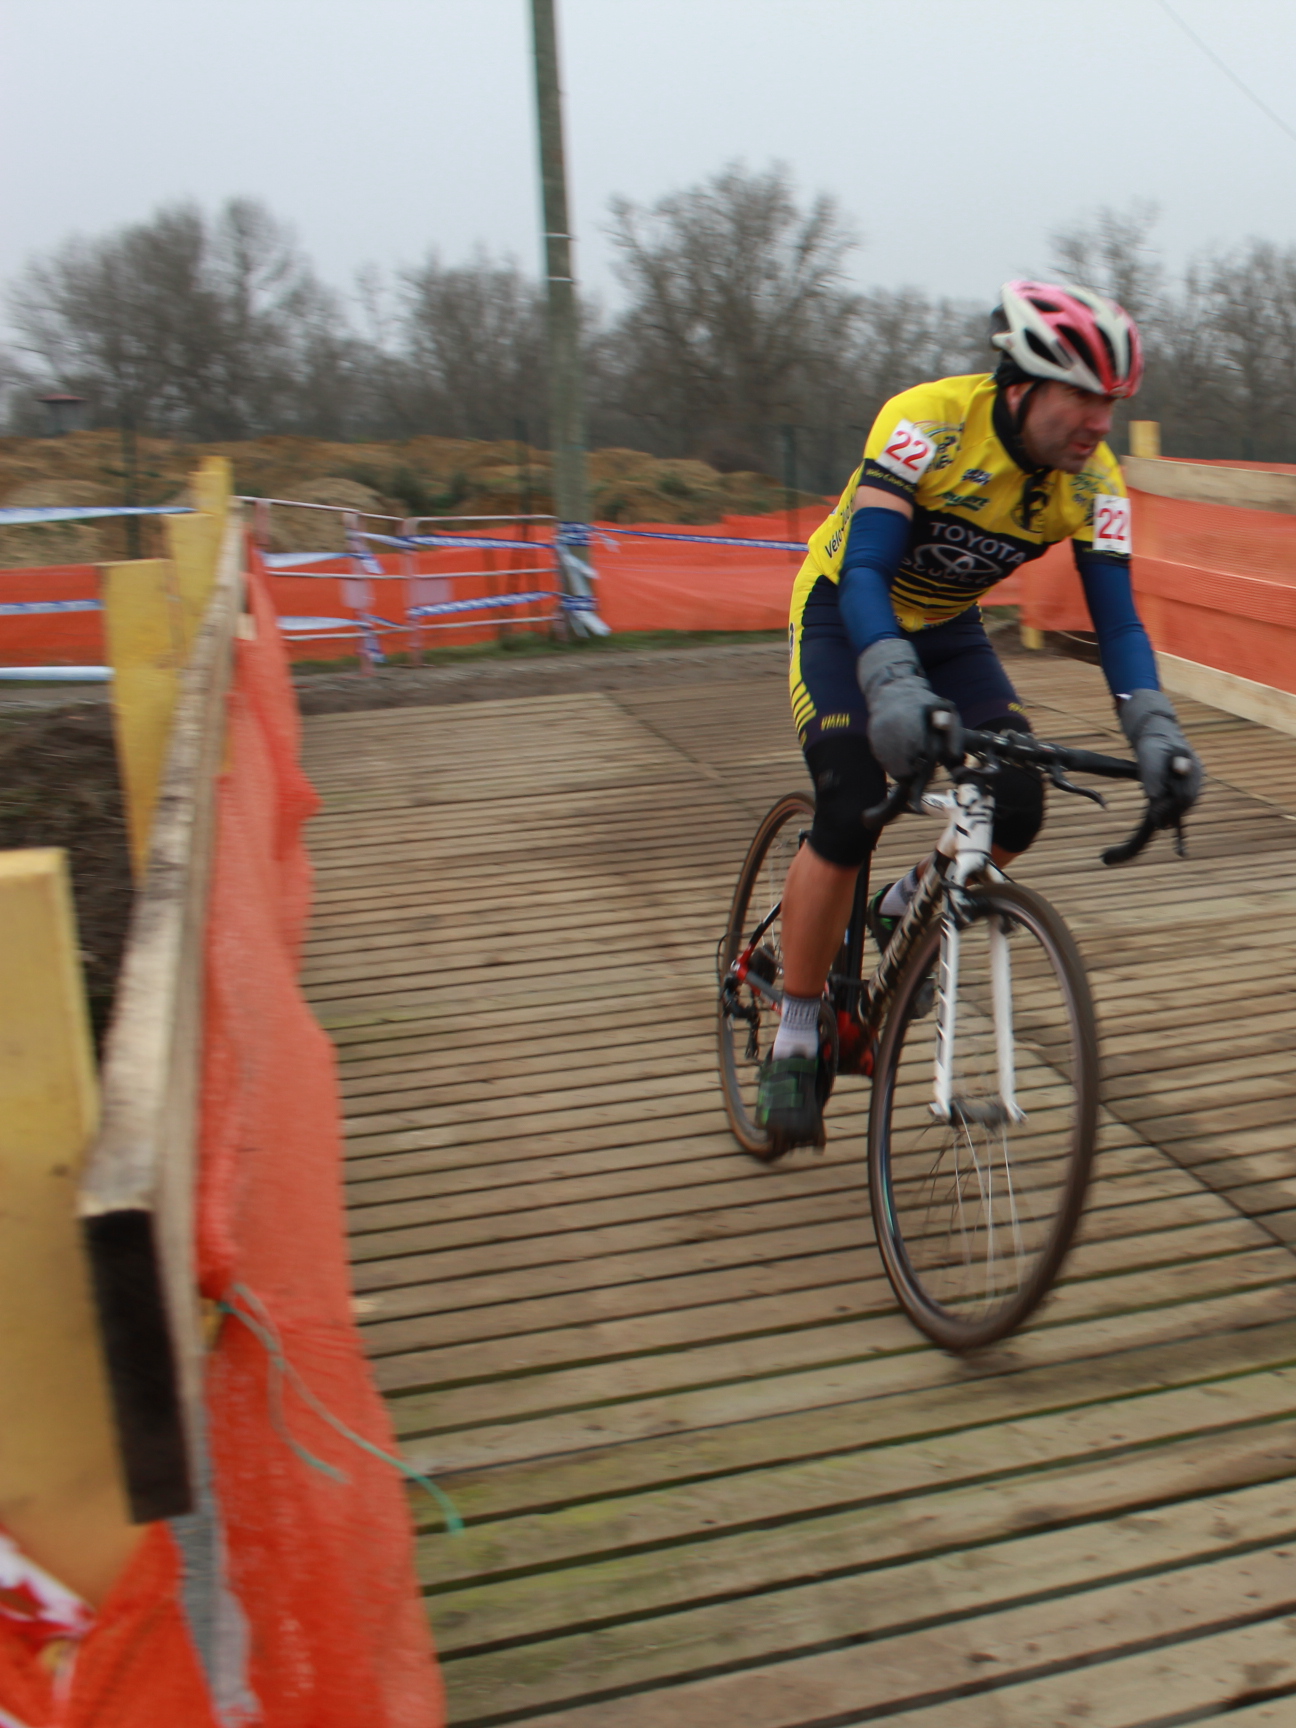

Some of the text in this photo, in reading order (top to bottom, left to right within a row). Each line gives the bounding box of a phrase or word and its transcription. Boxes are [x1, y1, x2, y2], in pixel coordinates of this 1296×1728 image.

[885, 430, 929, 471] 22
[929, 521, 1027, 565] TOYOTA
[1096, 507, 1128, 551] 22
